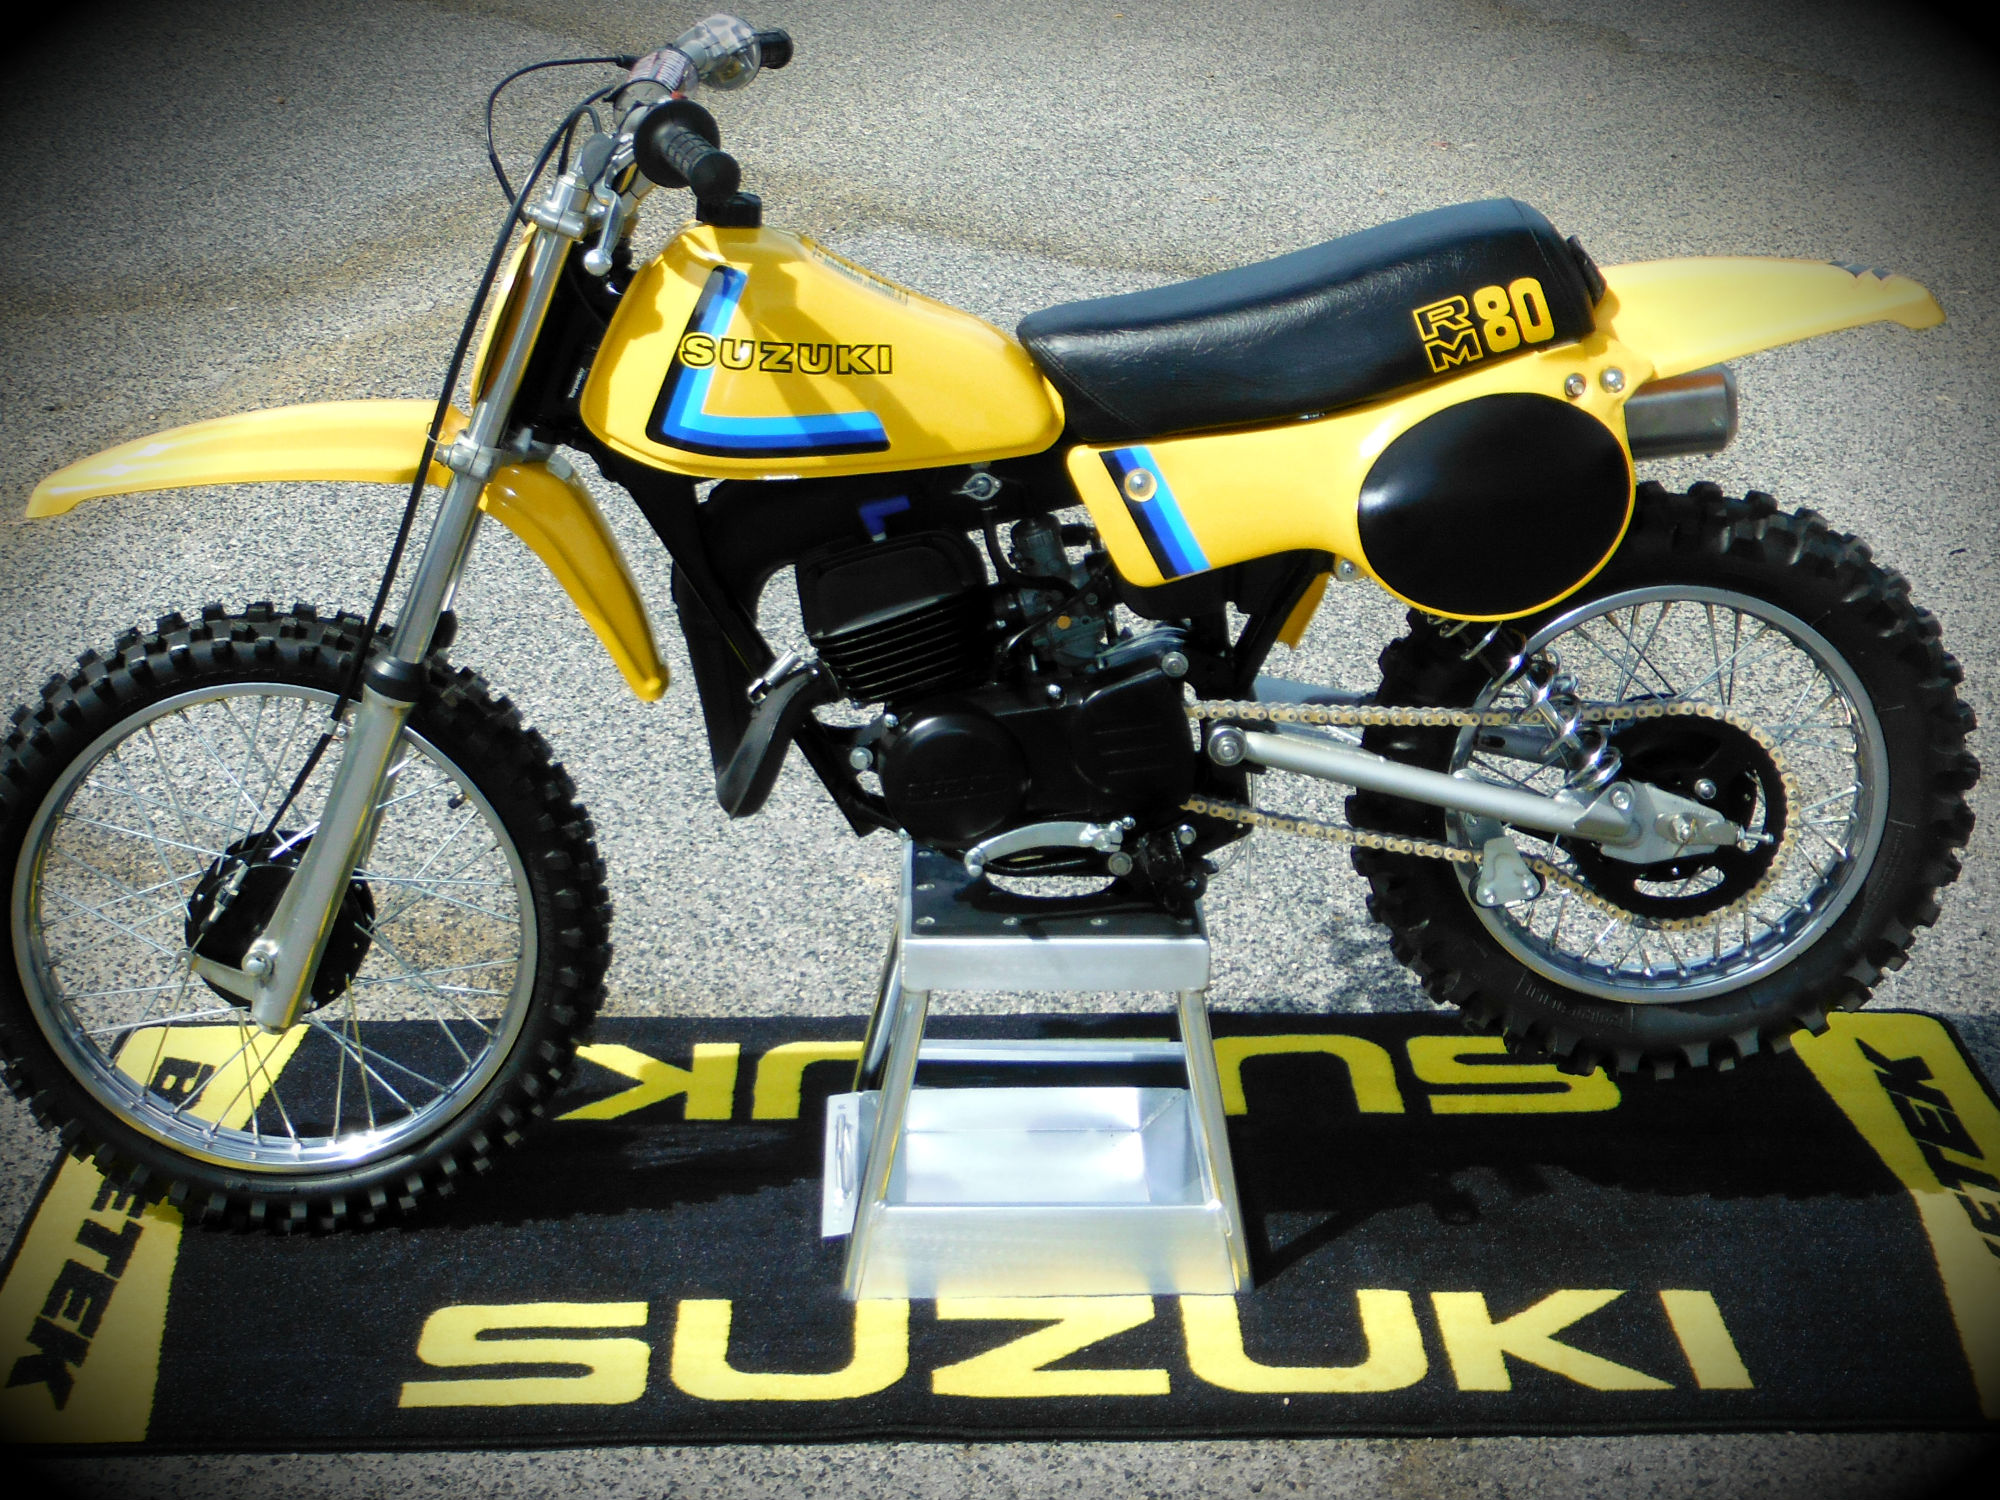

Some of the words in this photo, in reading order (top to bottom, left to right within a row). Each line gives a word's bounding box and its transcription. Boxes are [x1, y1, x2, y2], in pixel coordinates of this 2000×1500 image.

[1473, 277, 1556, 353] 80
[679, 334, 893, 375] SUZUKI
[400, 1289, 1756, 1408] SUZUKI
